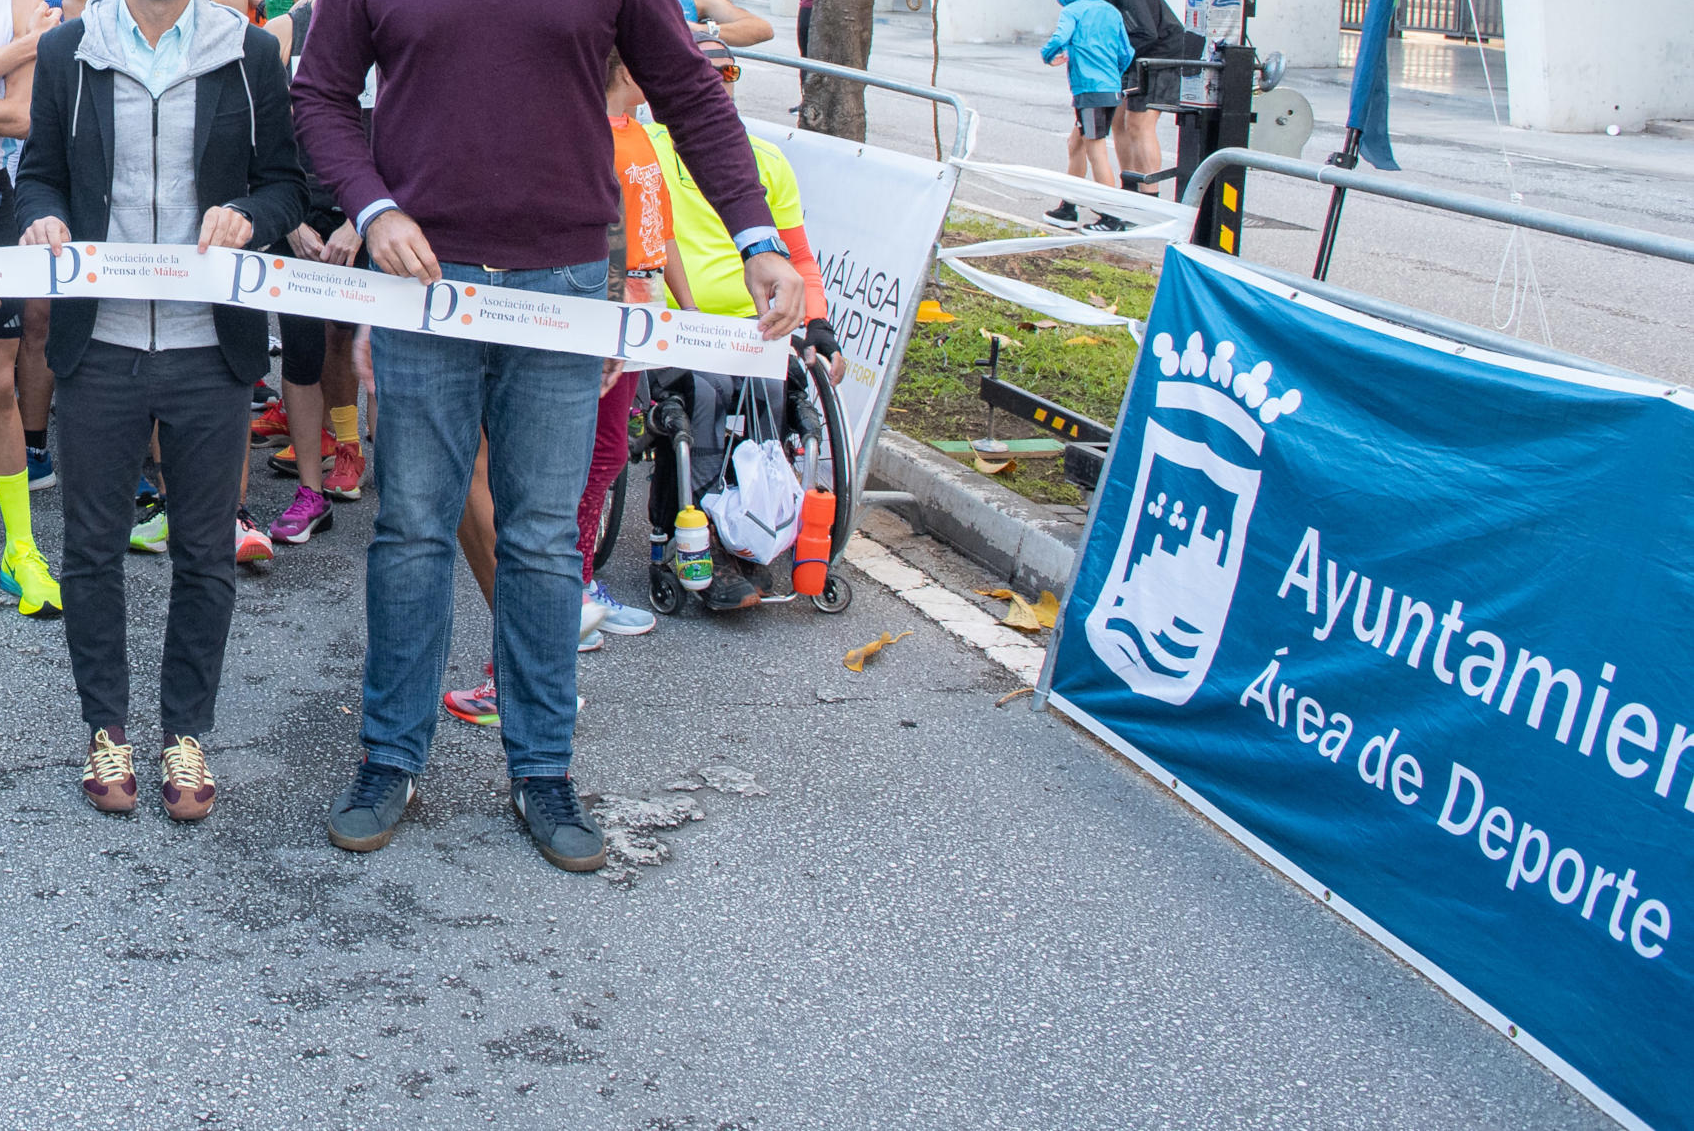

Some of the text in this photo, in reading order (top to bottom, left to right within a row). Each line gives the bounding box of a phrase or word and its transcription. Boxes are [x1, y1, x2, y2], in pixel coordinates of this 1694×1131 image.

[102, 252, 179, 264] Asociación de la
[102, 266, 189, 278] Prensa de Málaga
[289, 269, 367, 288] Asociación de la
[288, 281, 376, 303] Prensa de Málaga
[481, 296, 561, 315] Asociación de la
[479, 308, 570, 329] Prensa de Málaga
[677, 321, 758, 341] Asociación de la
[676, 334, 764, 354] Prensa de Málaga
[1239, 645, 1672, 961] Área de Deporte
